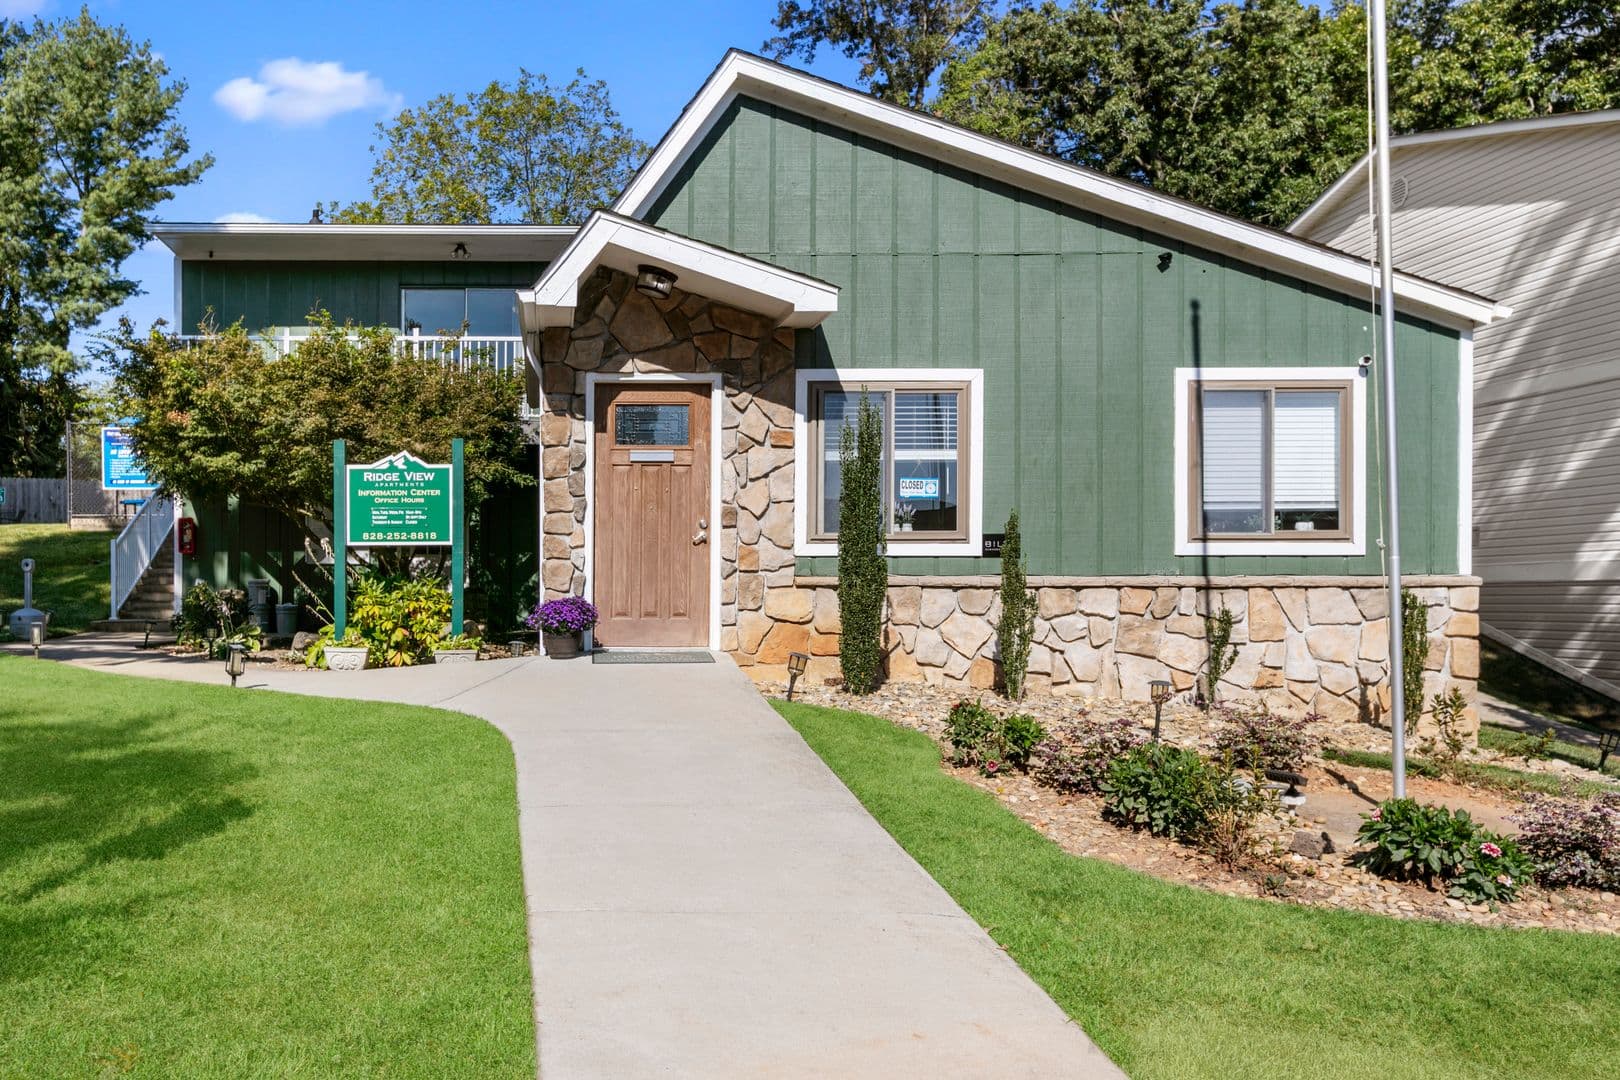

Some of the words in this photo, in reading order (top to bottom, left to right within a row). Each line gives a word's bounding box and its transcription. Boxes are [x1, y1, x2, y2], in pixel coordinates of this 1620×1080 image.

[363, 472, 400, 482] RIDGE
[404, 471, 435, 481] VIEW
[901, 480, 924, 490] CLOSED
[410, 488, 440, 496] CENTER
[363, 532, 437, 540] 828-252-8818
[984, 540, 1006, 548] BIL
